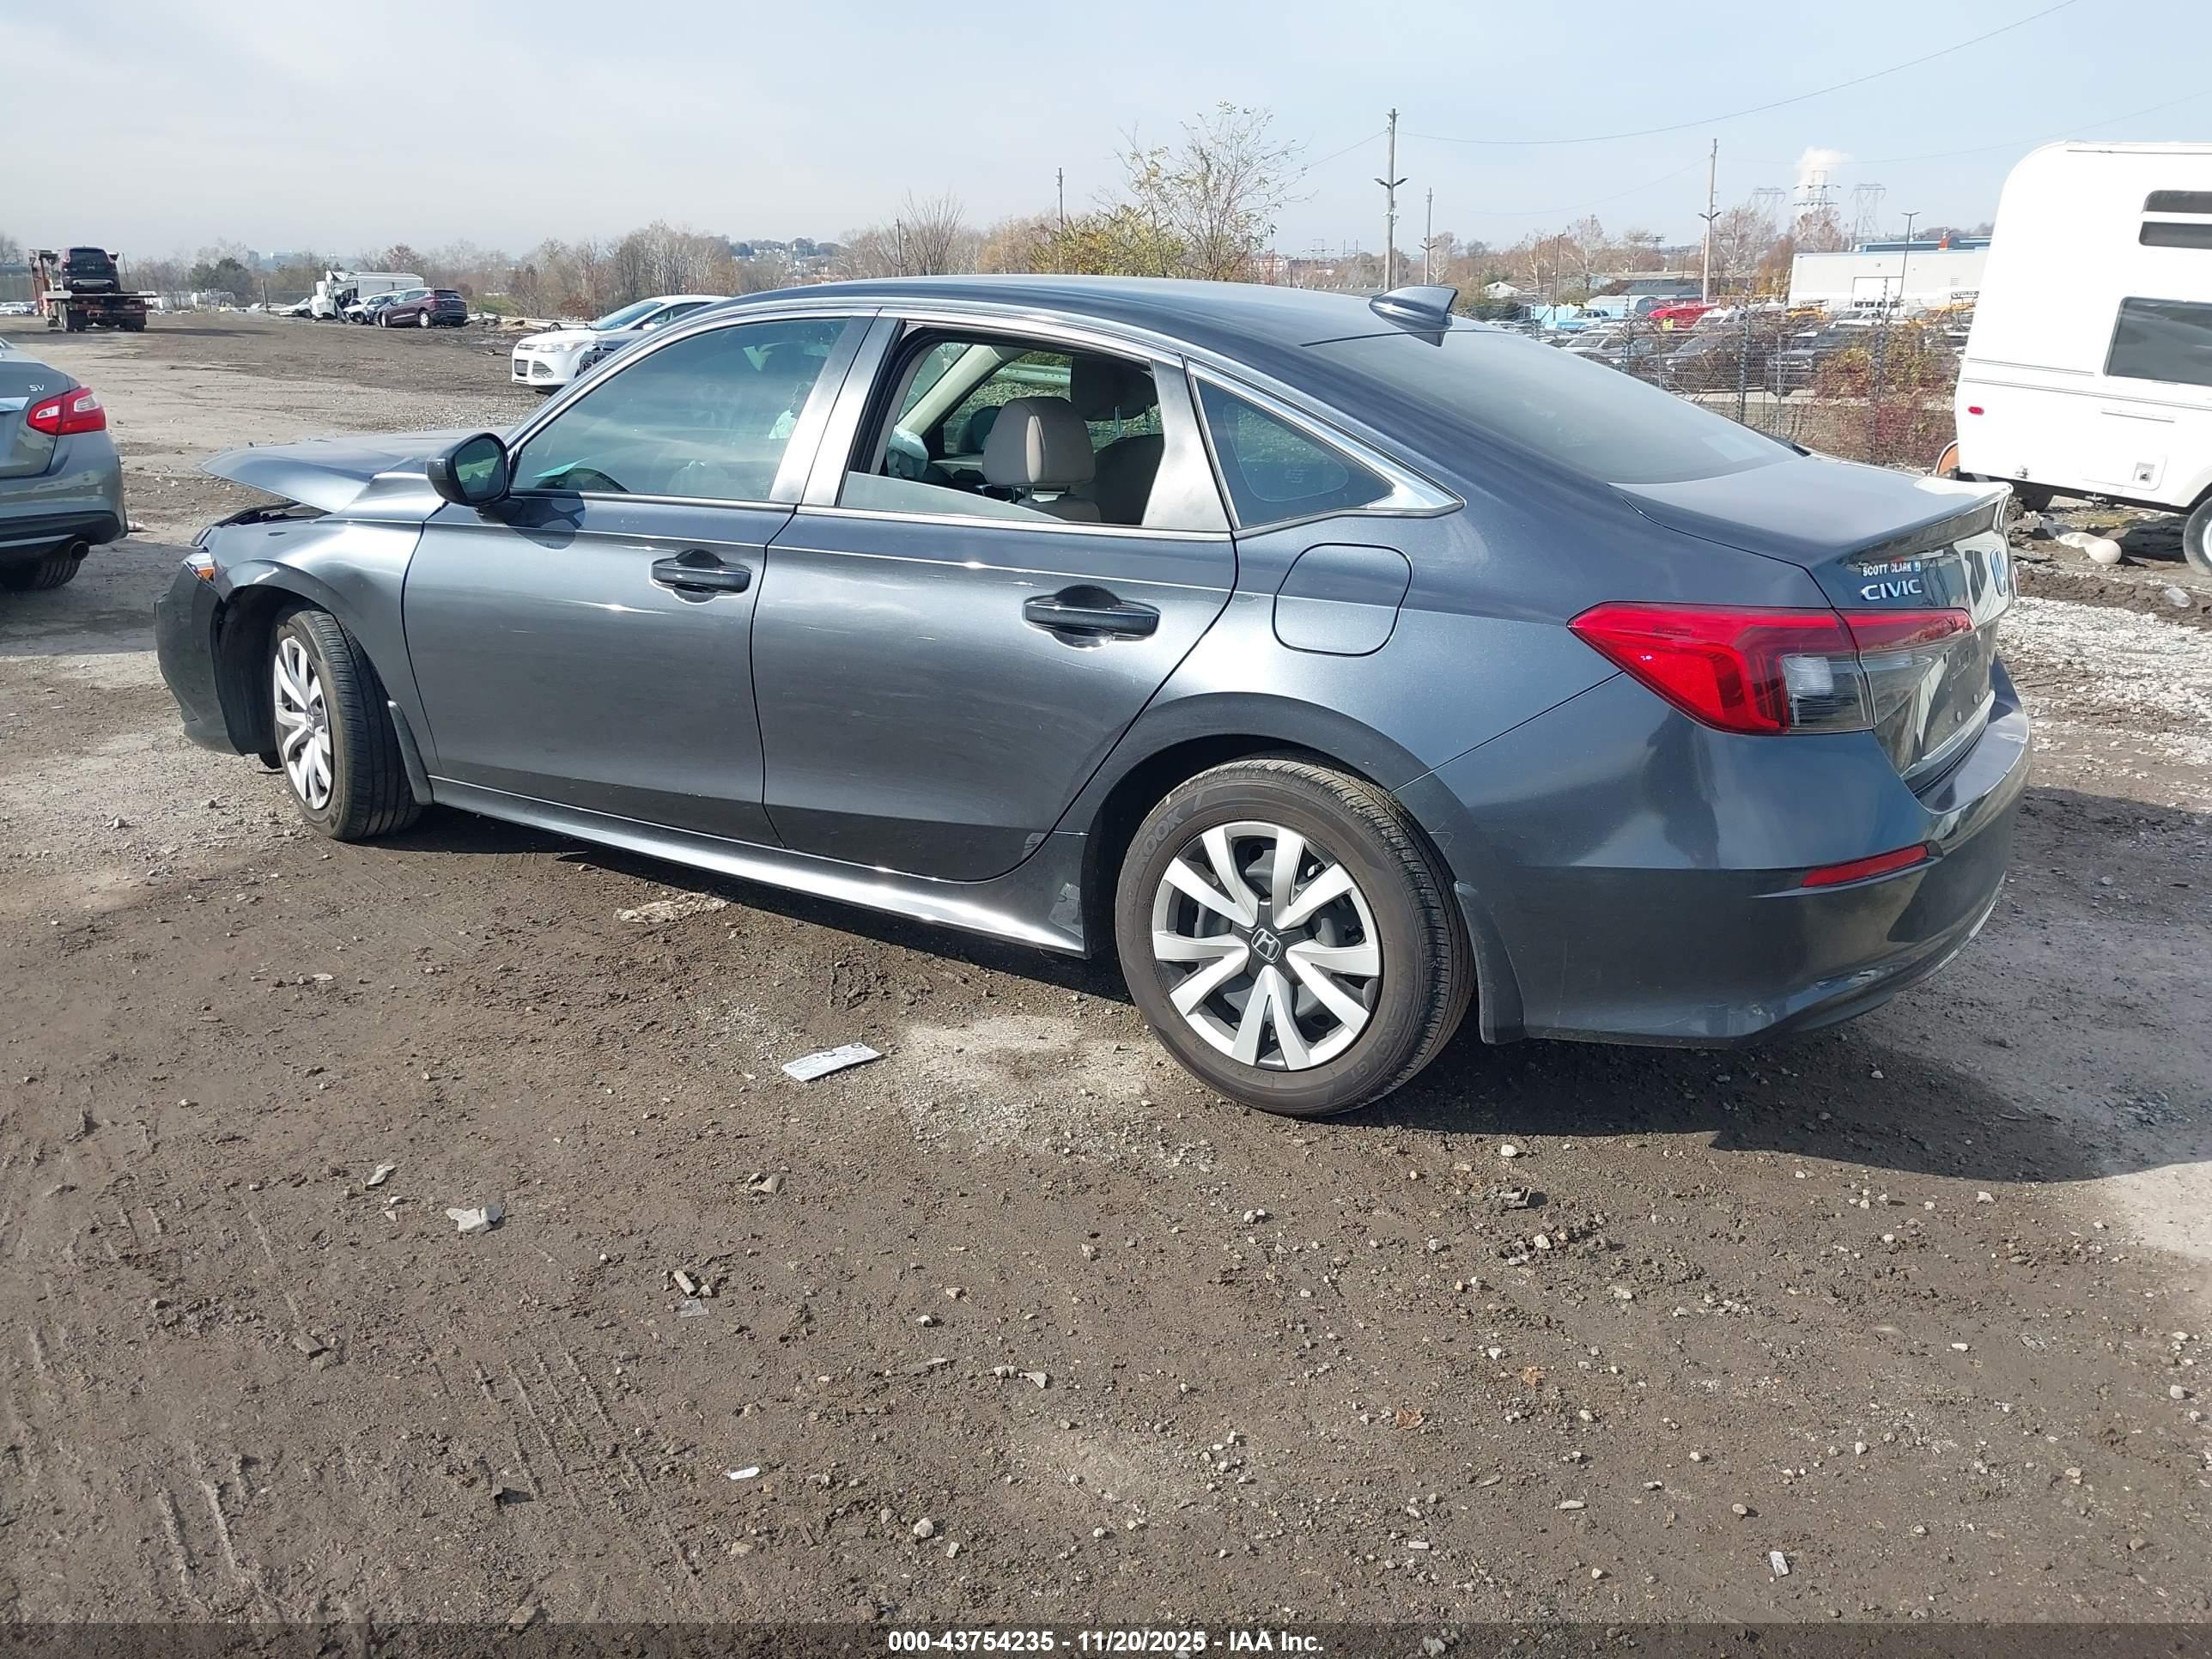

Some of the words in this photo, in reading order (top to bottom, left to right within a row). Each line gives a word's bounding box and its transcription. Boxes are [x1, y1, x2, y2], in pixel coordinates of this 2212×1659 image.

[1863, 563, 1887, 577] SCOTT
[1890, 561, 1912, 574] CLARK
[1861, 579, 1923, 600] CIVIC
